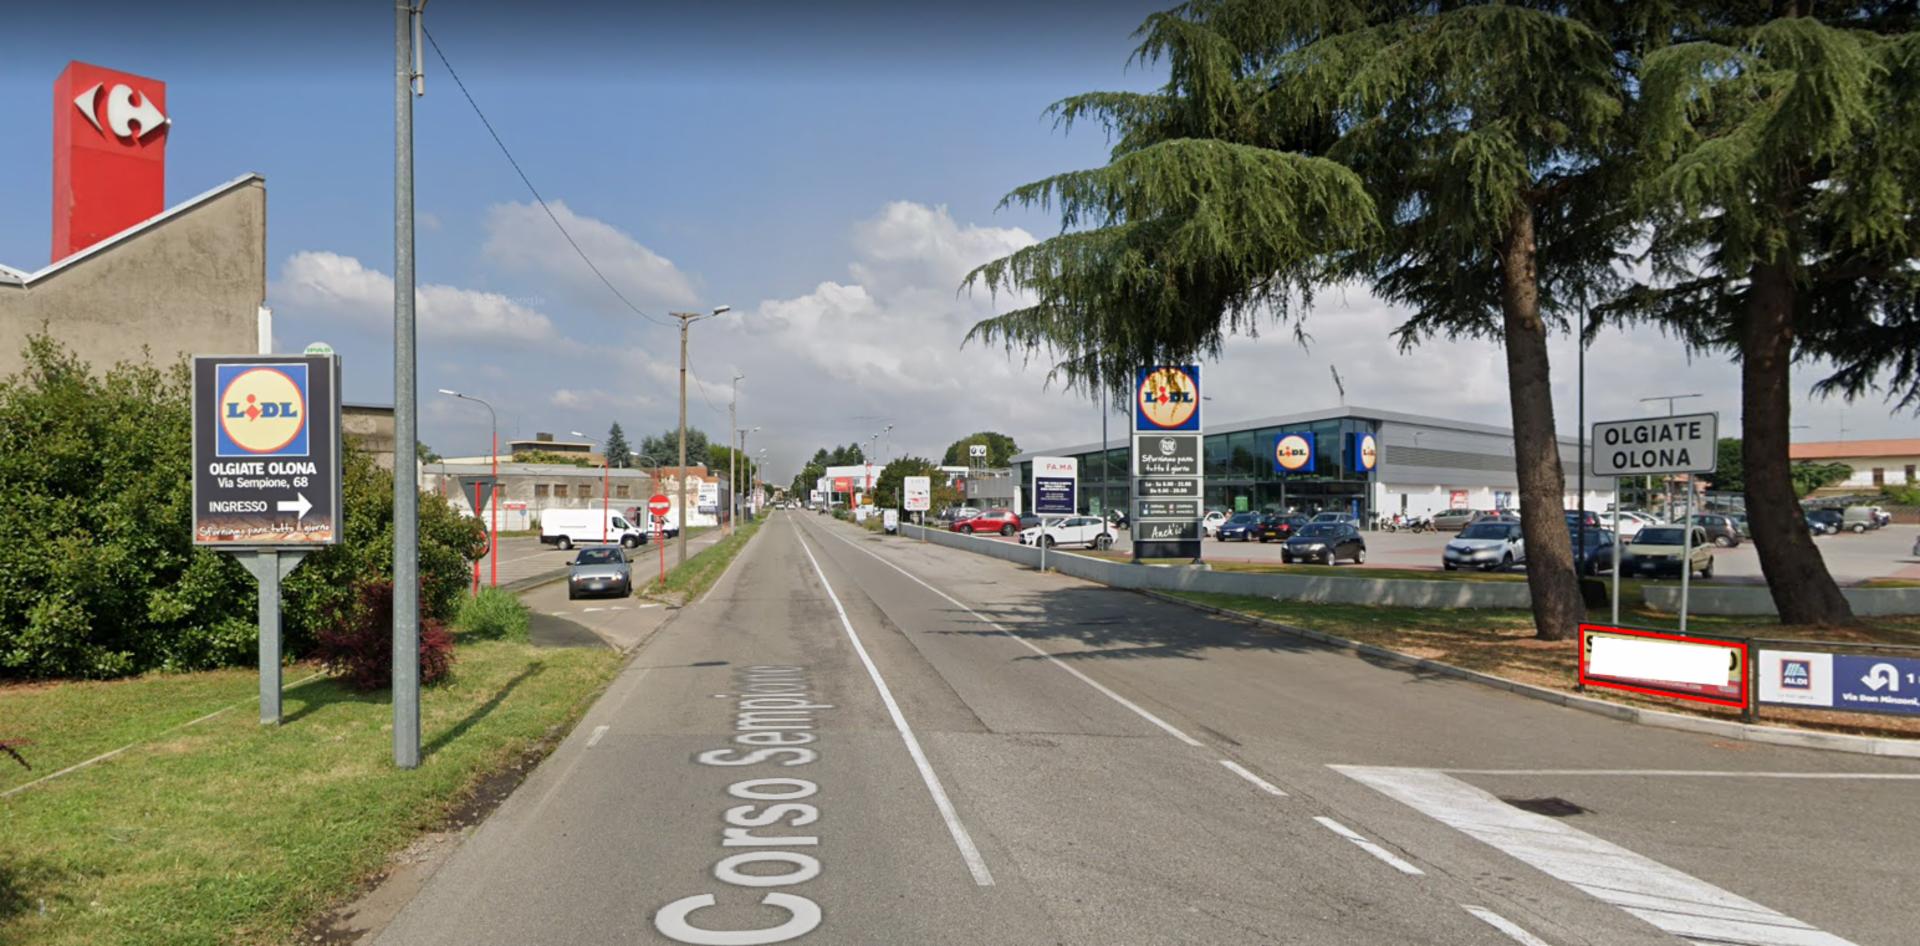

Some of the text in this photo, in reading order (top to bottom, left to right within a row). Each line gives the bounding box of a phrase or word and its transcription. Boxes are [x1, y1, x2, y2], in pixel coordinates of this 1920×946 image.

[1604, 421, 1702, 446] OLGIATE
[1612, 448, 1691, 469] OLONA
[209, 461, 317, 476] OLGIATE OLONA
[218, 477, 308, 489] Via Sempione, 68
[209, 501, 268, 513] INGRESSO
[271, 523, 294, 533] tutto
[303, 524, 330, 535] giorno
[1784, 677, 1808, 686] ALDI
[1842, 693, 1857, 702] Via
[1860, 694, 1879, 703] Don
